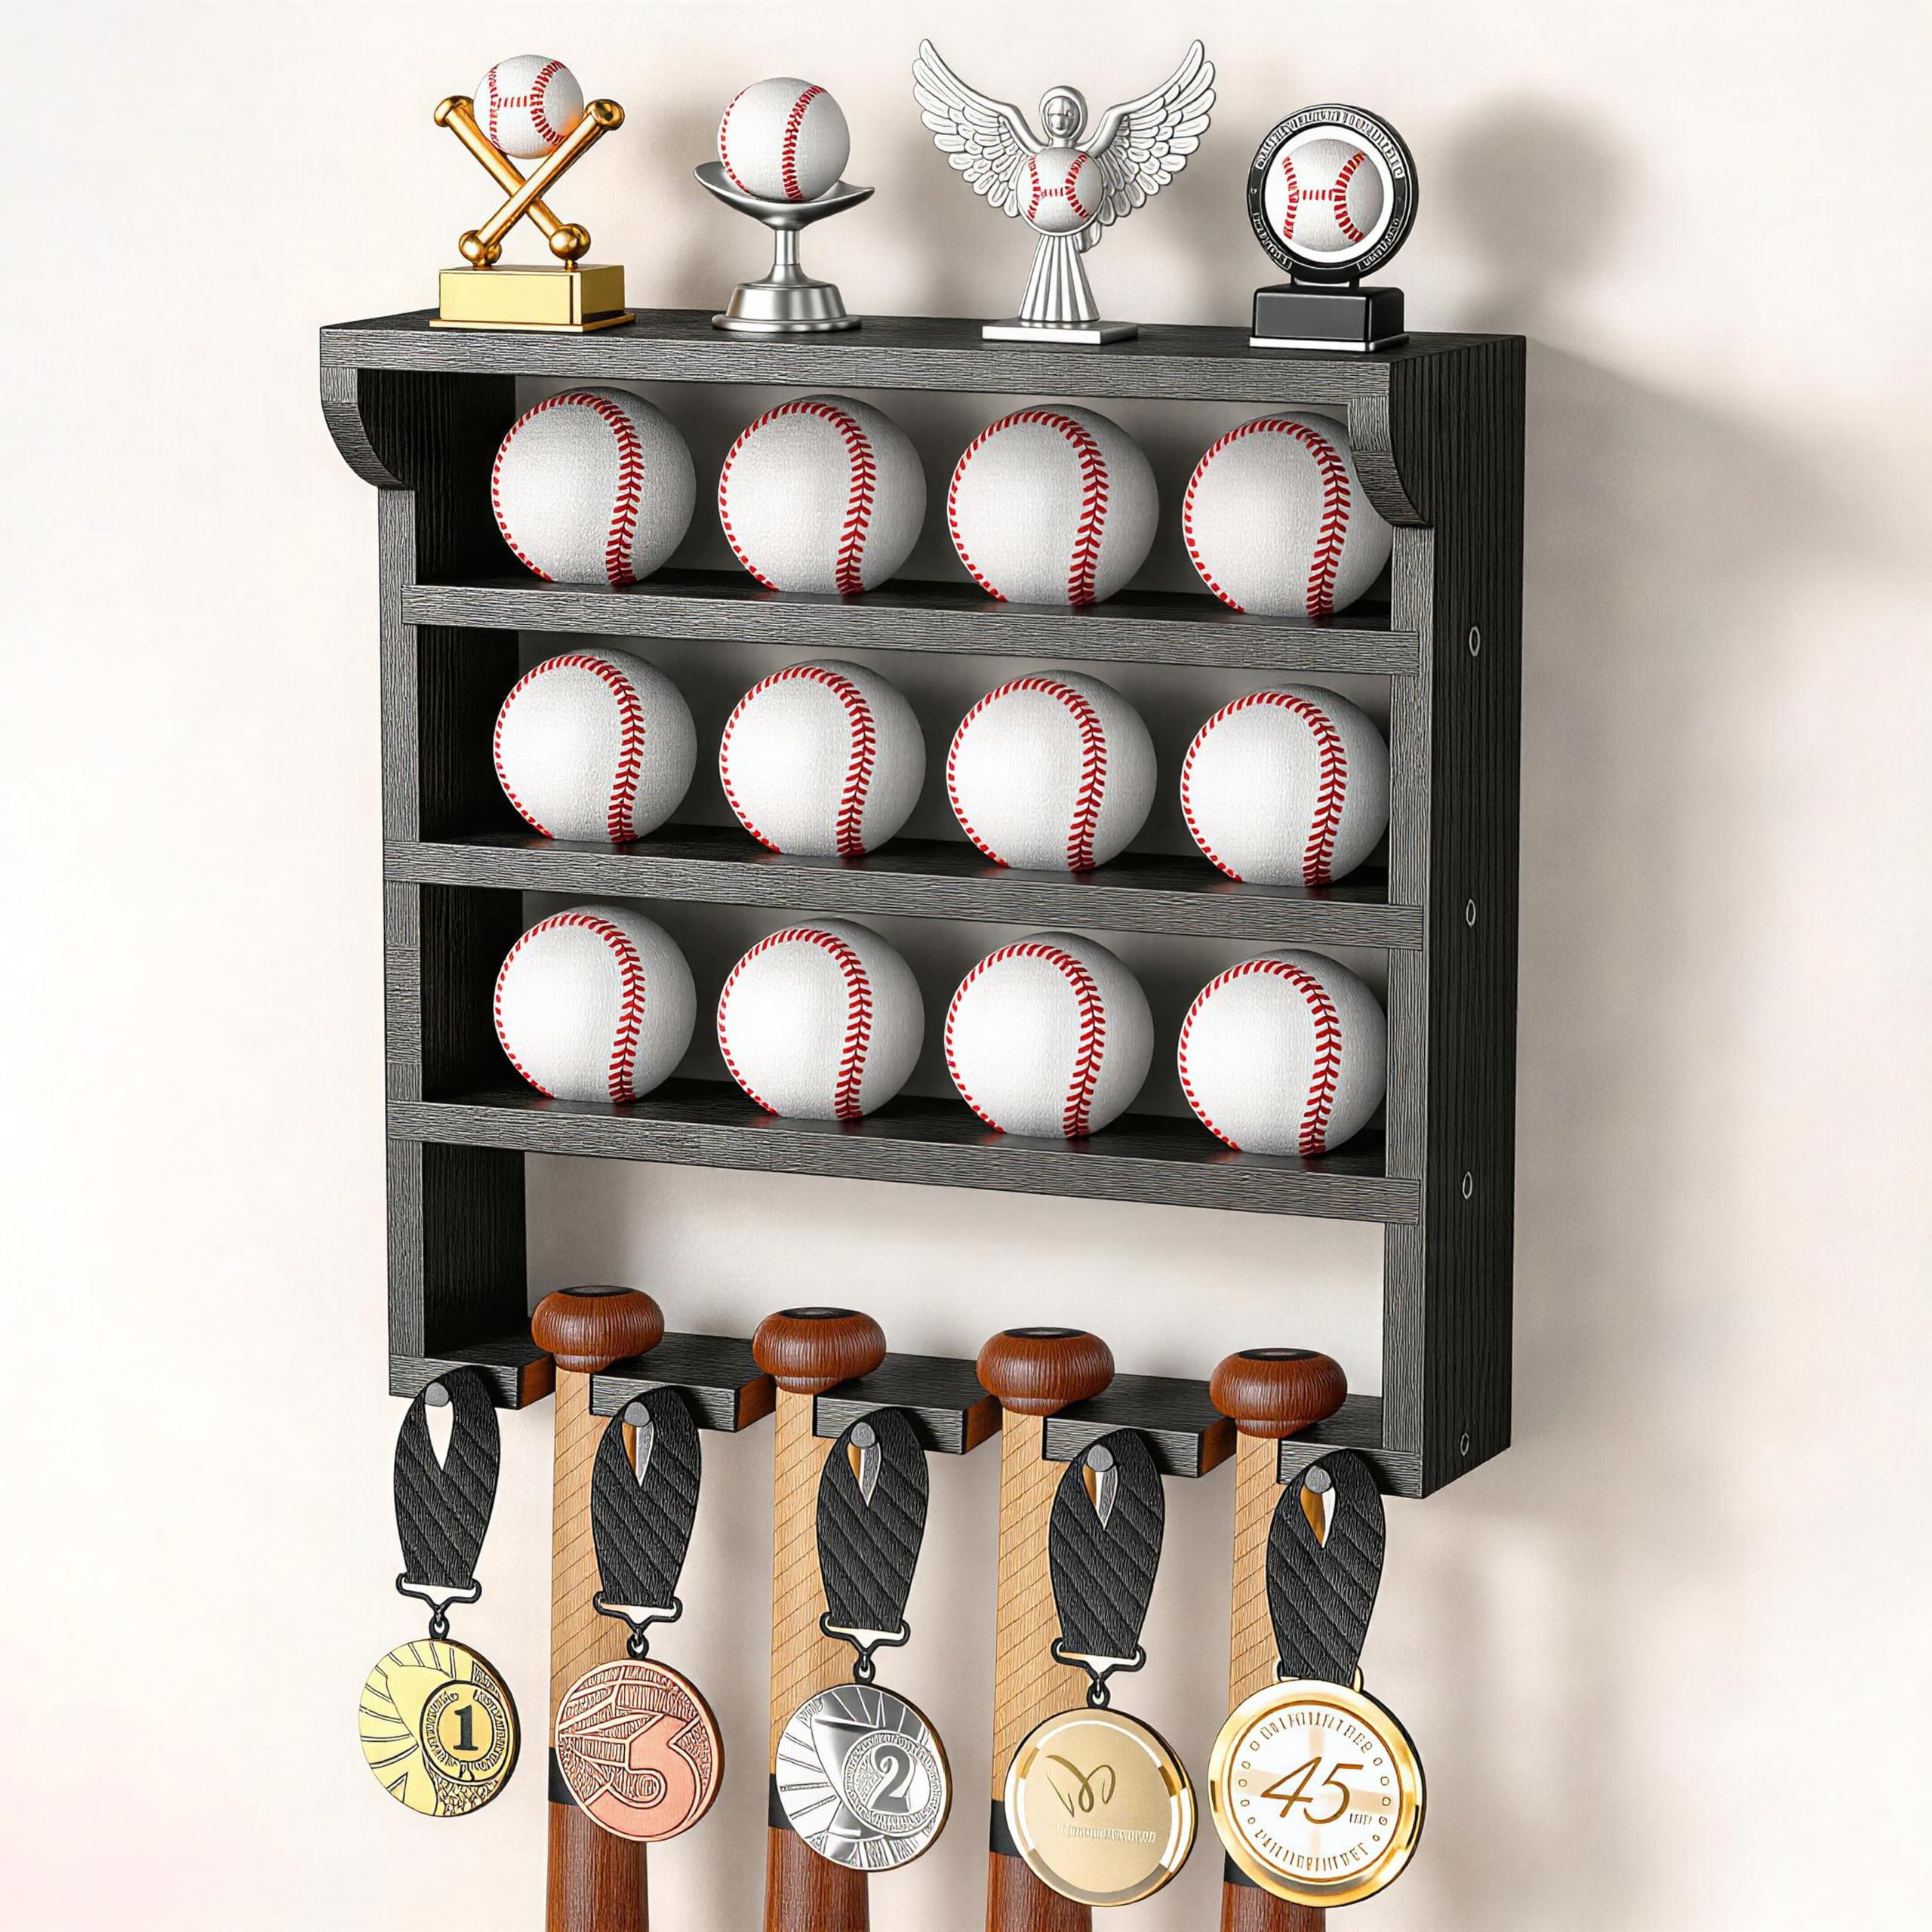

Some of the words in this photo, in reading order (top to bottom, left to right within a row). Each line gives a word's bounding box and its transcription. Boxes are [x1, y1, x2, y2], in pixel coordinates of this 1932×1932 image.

[453, 1704, 478, 1751] 1
[871, 1744, 912, 1814] 2
[1260, 1755, 1364, 1825] 45
